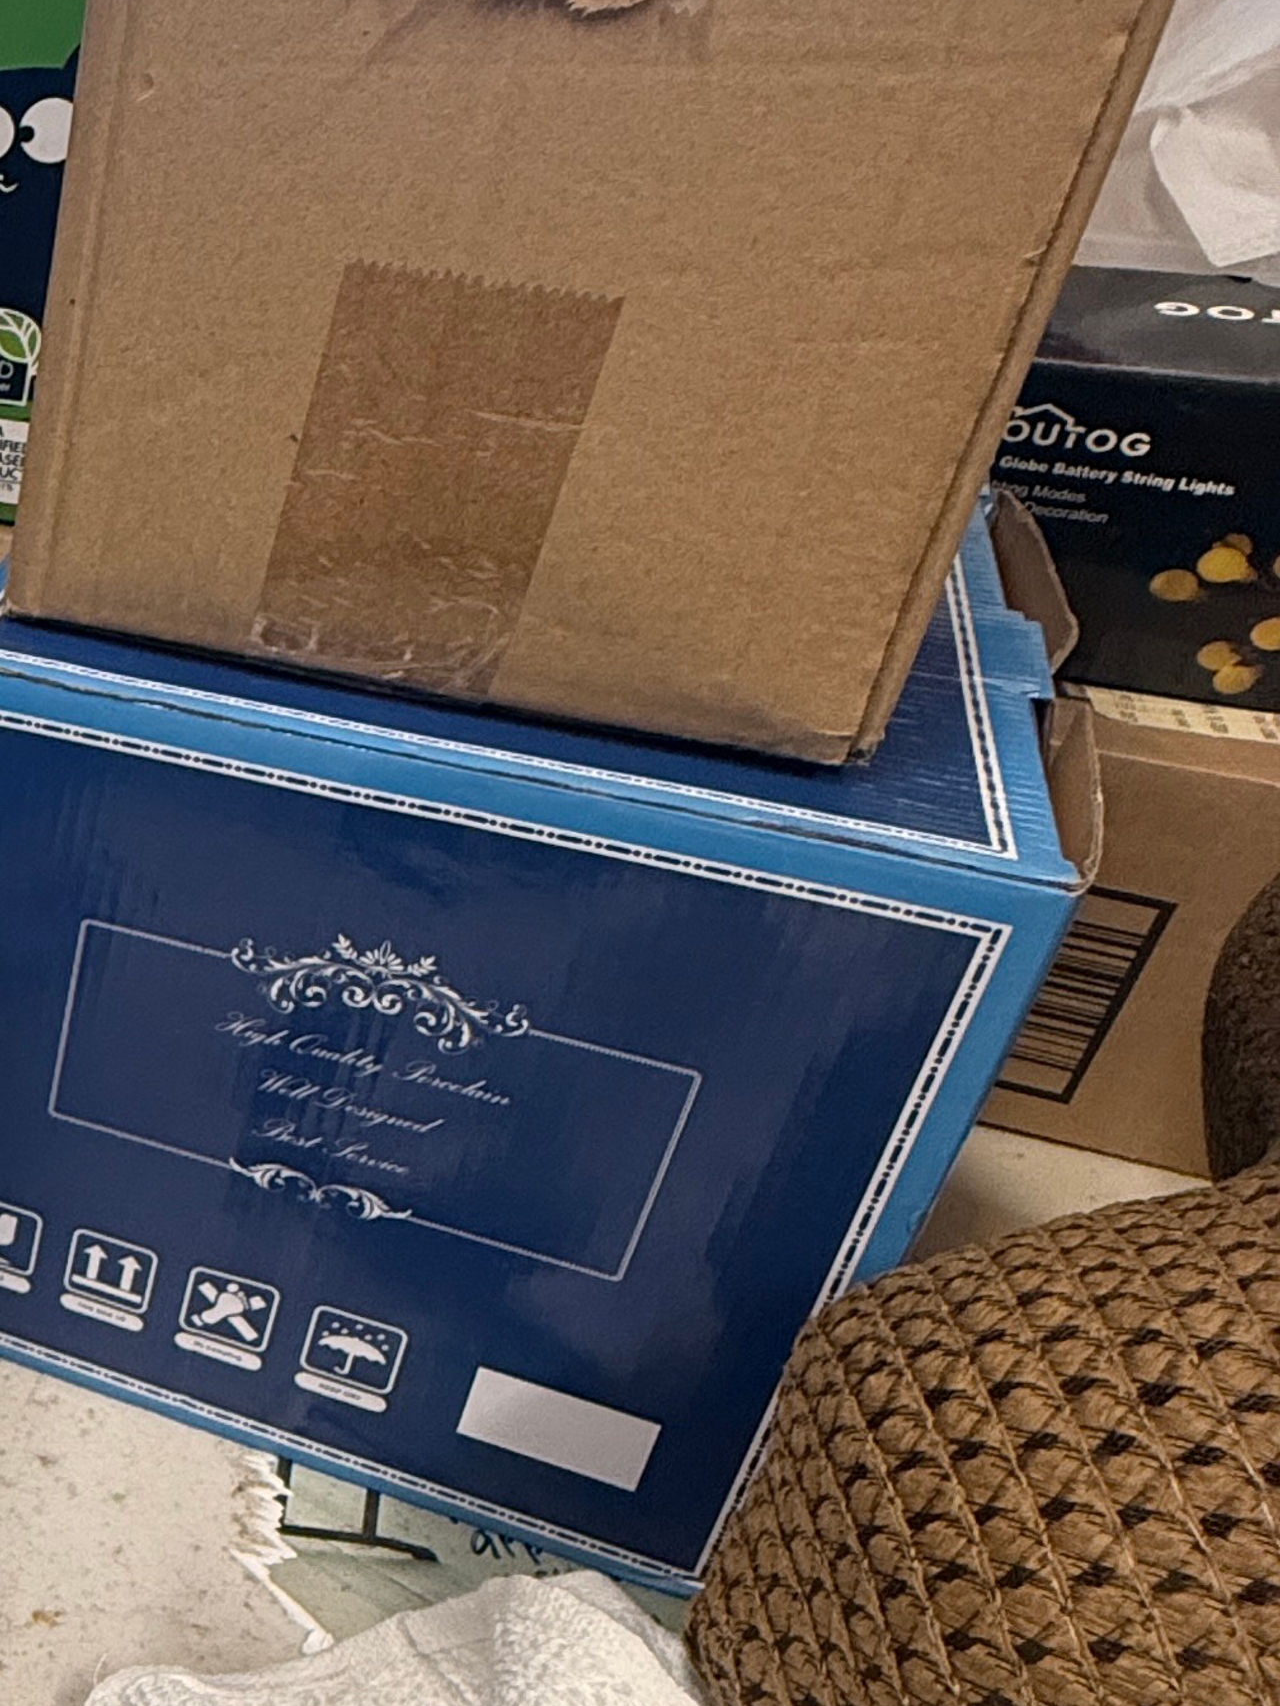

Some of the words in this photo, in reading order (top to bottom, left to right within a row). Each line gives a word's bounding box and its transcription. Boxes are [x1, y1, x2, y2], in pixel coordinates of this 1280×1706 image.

[1002, 417, 1152, 457] OUTOG
[999, 455, 1049, 474] Globe
[1052, 462, 1118, 484] Battery
[1120, 470, 1174, 491] String
[1178, 477, 1237, 496] Lights
[1032, 484, 1087, 503] Modes
[214, 1012, 289, 1047] High
[289, 1034, 383, 1078] Quality
[392, 1060, 511, 1105] Porcelain
[257, 1068, 321, 1100] Well
[313, 1087, 444, 1133] Designed
[252, 1118, 323, 1148] Best
[322, 1138, 410, 1175] Service
